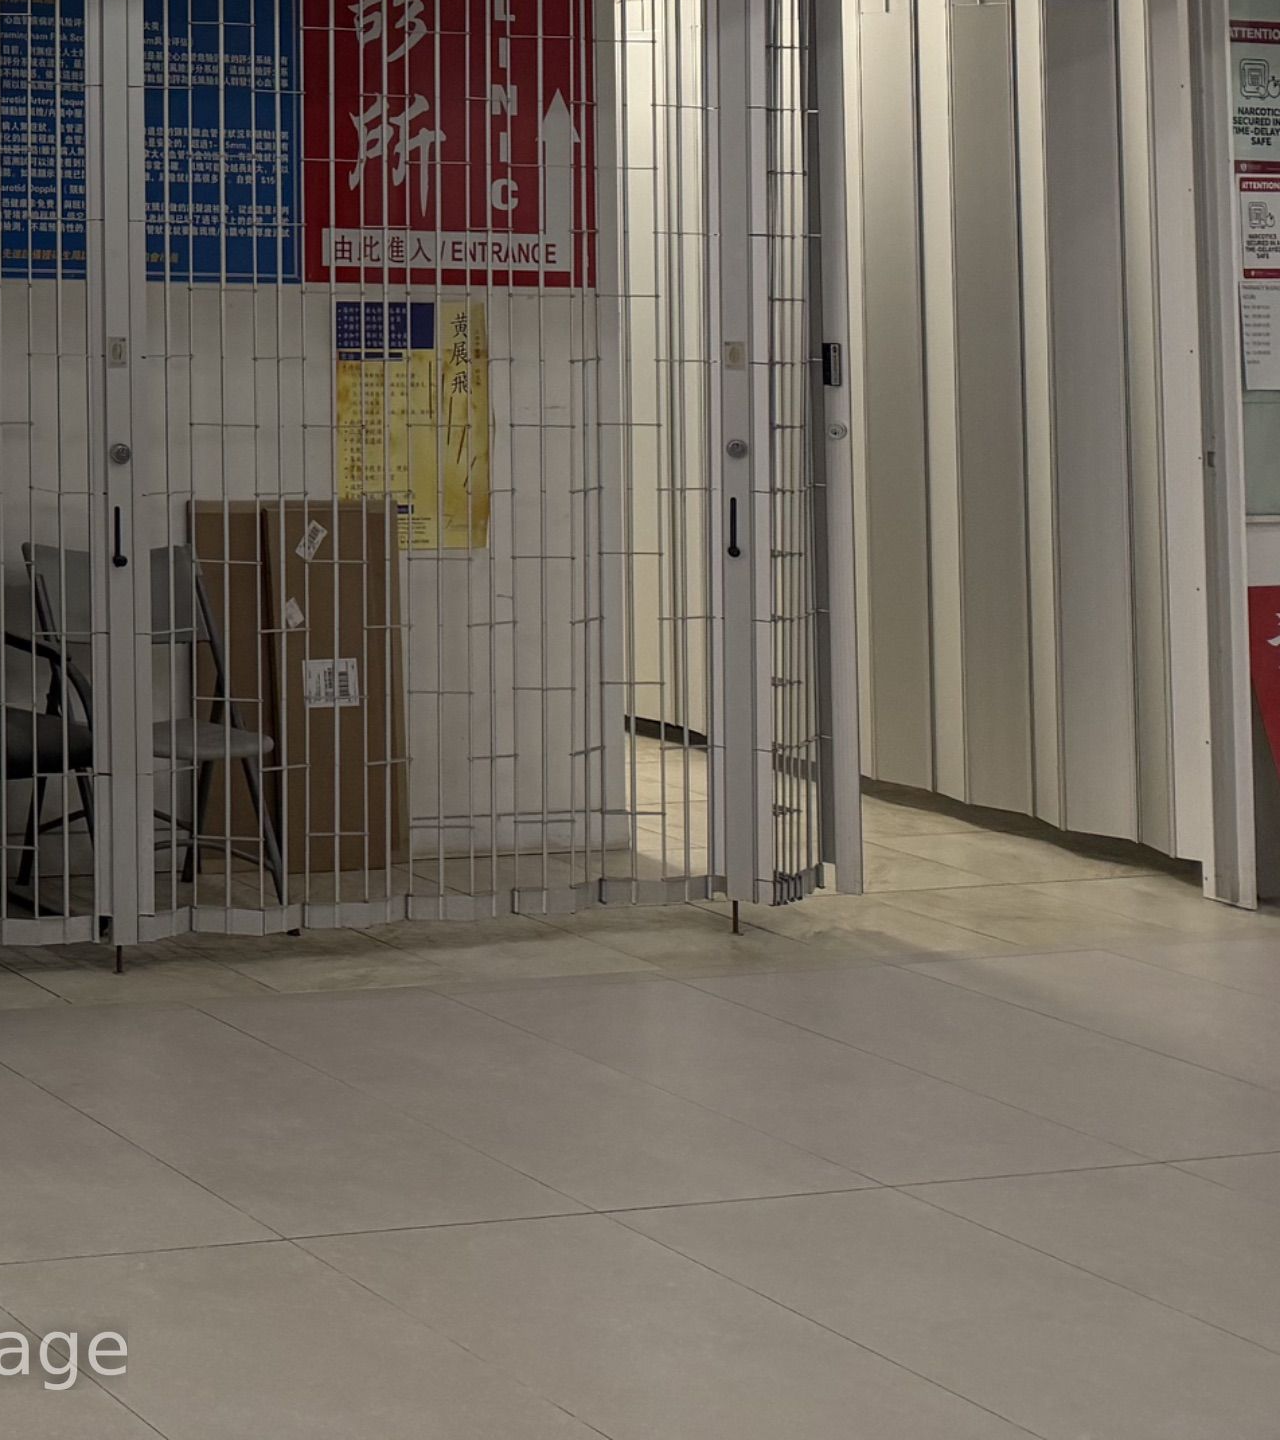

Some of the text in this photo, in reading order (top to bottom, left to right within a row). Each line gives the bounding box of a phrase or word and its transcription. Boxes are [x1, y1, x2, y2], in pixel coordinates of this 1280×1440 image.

[1232, 116, 1271, 126] SECURED
[1251, 136, 1272, 146] SAFE
[333, 234, 432, 263] 由此進入
[451, 240, 557, 265] ENTRANCE
